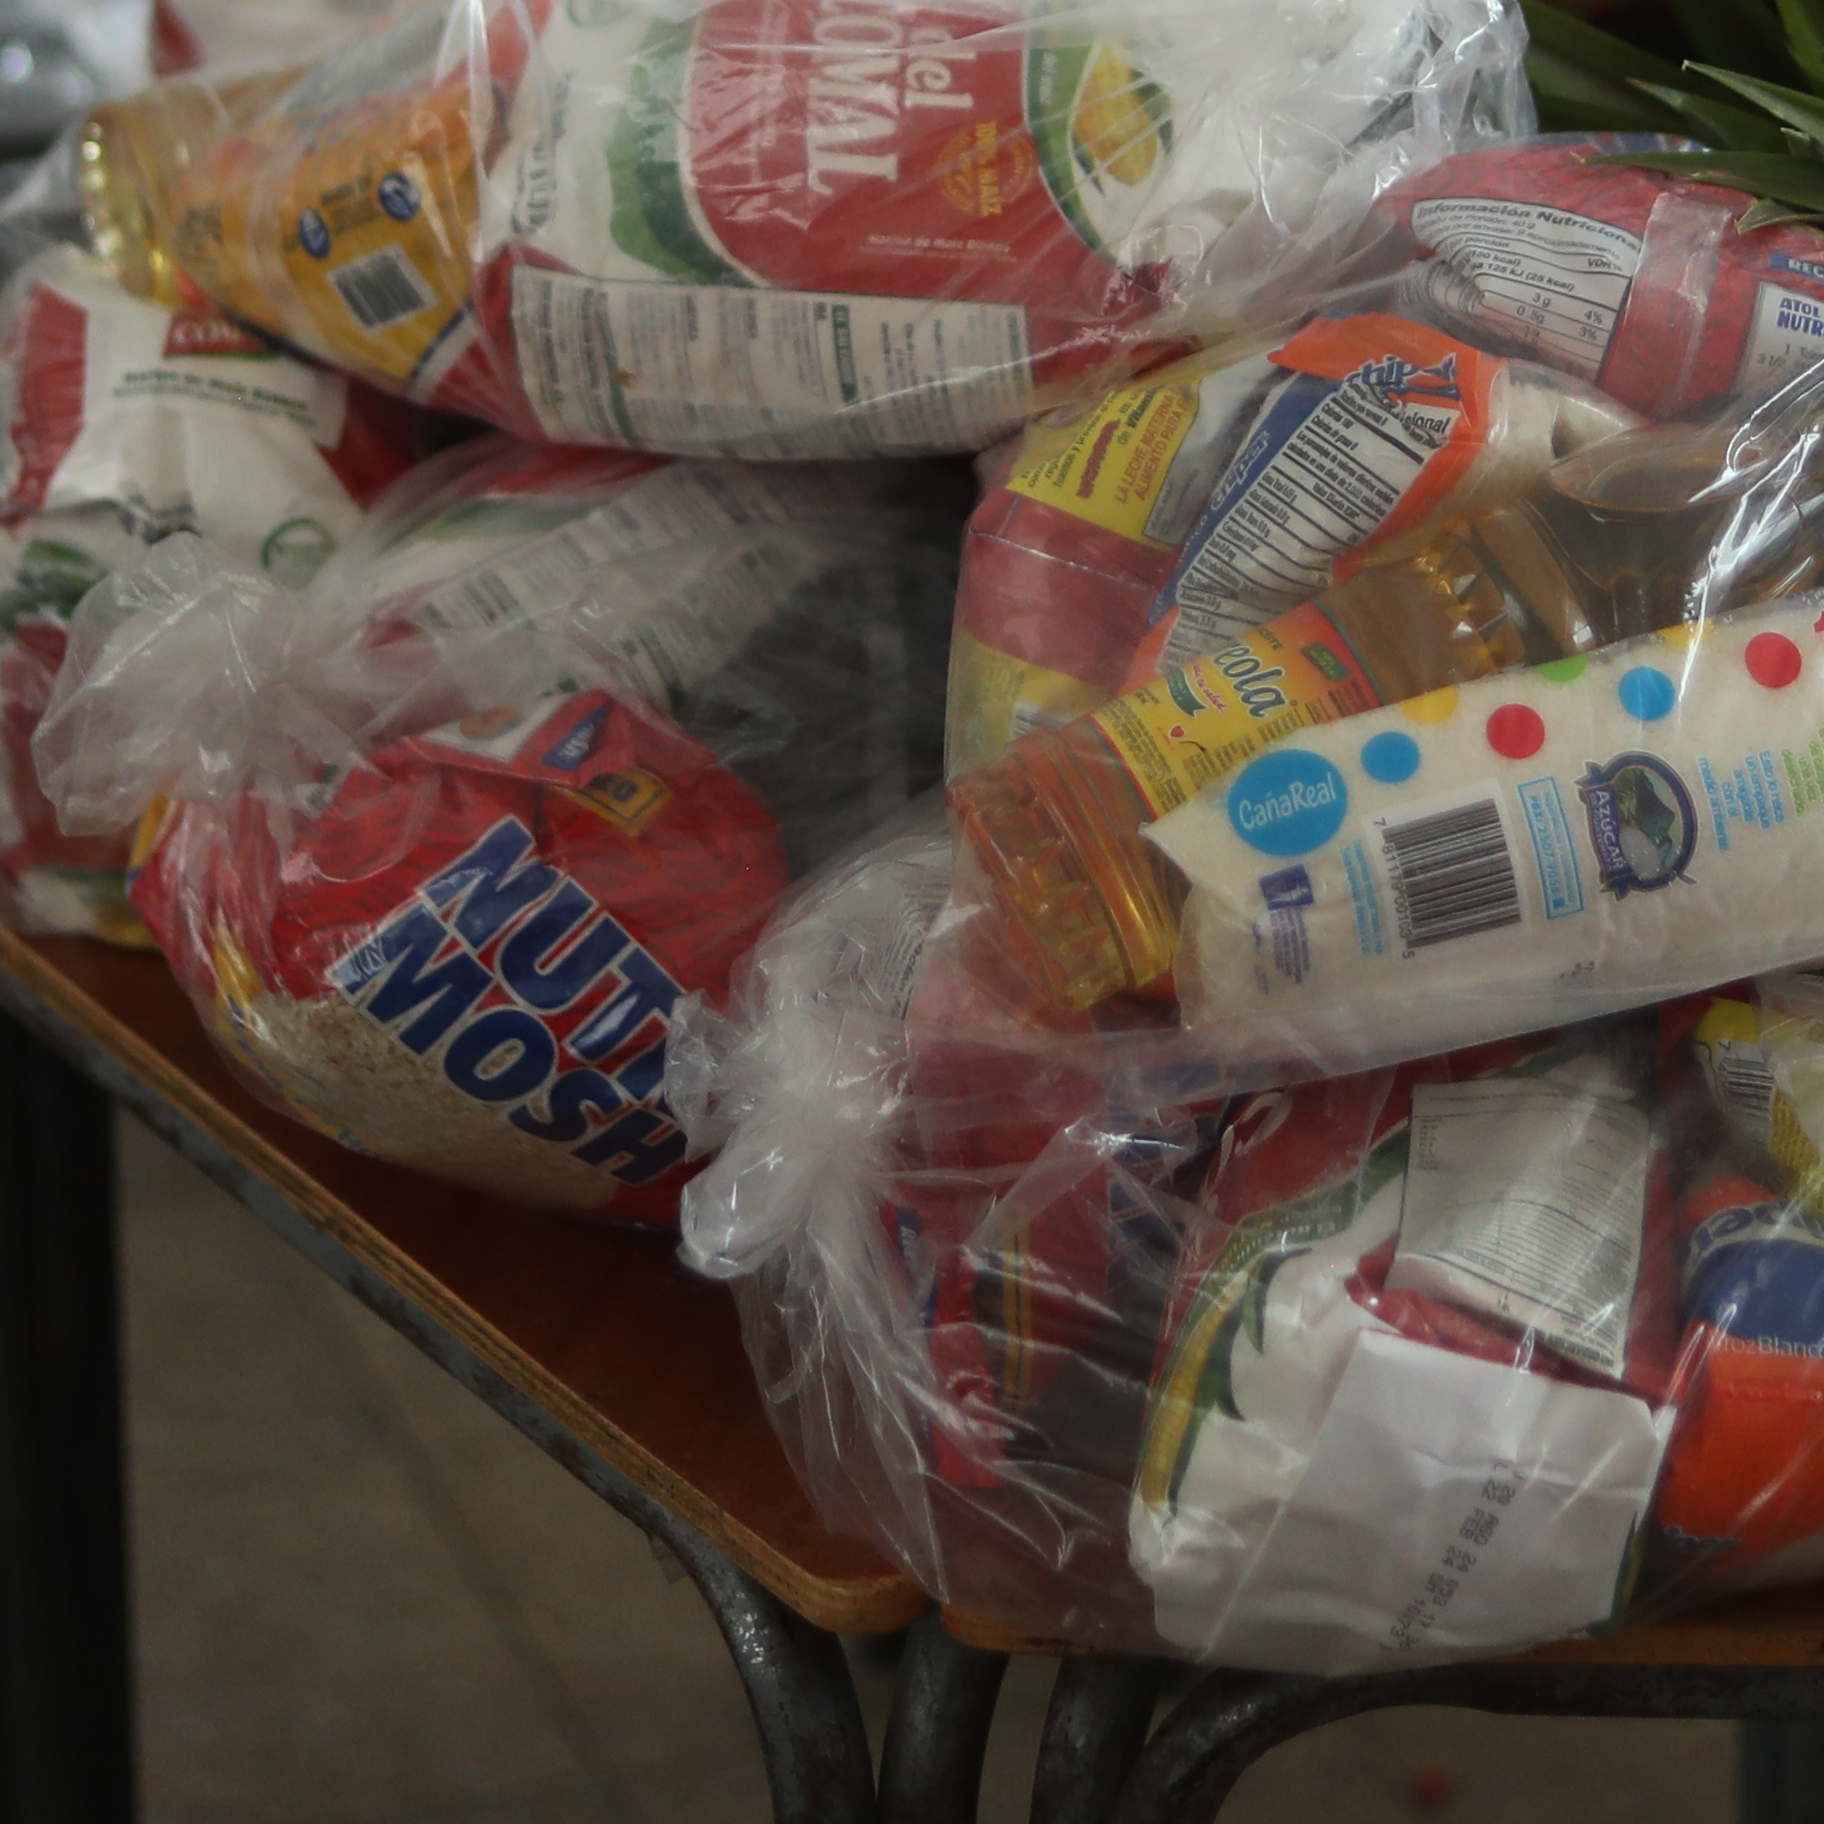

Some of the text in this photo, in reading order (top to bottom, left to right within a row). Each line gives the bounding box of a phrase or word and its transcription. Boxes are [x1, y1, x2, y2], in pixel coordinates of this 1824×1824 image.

[901, 24, 974, 114] del
[1415, 197, 1532, 225] Información
[1582, 307, 1606, 325] 4%
[1778, 295, 1822, 321] ATOL
[1577, 324, 1600, 342] 3%
[1238, 771, 1337, 831] CañaReal
[1595, 789, 1626, 870] AZÚCAR
[416, 812, 706, 1101] NUT
[324, 904, 692, 1188] MOSH
[1456, 1503, 1488, 1543] FEB
[1439, 1544, 1463, 1570] 24
